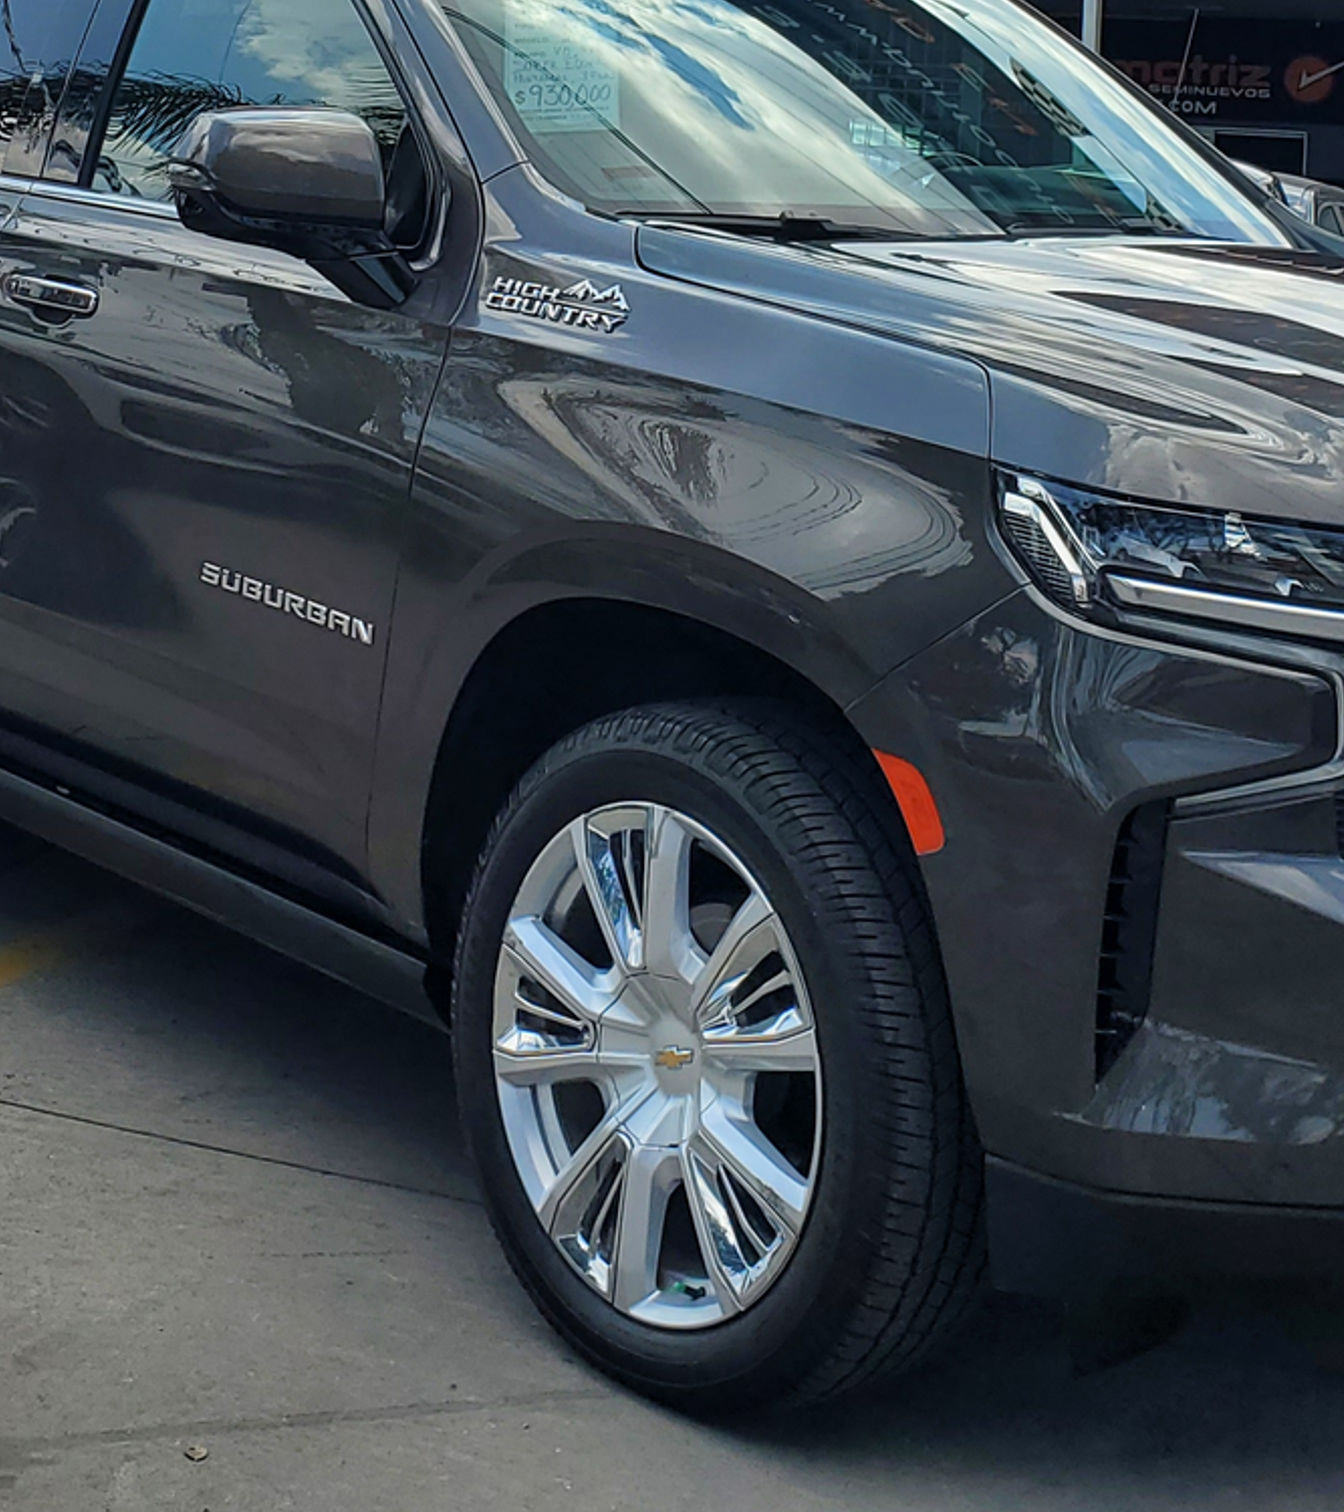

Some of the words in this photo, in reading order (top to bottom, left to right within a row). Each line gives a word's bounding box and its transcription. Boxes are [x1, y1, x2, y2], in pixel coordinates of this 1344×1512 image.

[514, 83, 611, 109] $930,000
[493, 275, 558, 302] HIGH
[485, 291, 629, 333] COUNTRY
[200, 561, 375, 645] SUBURBAN
